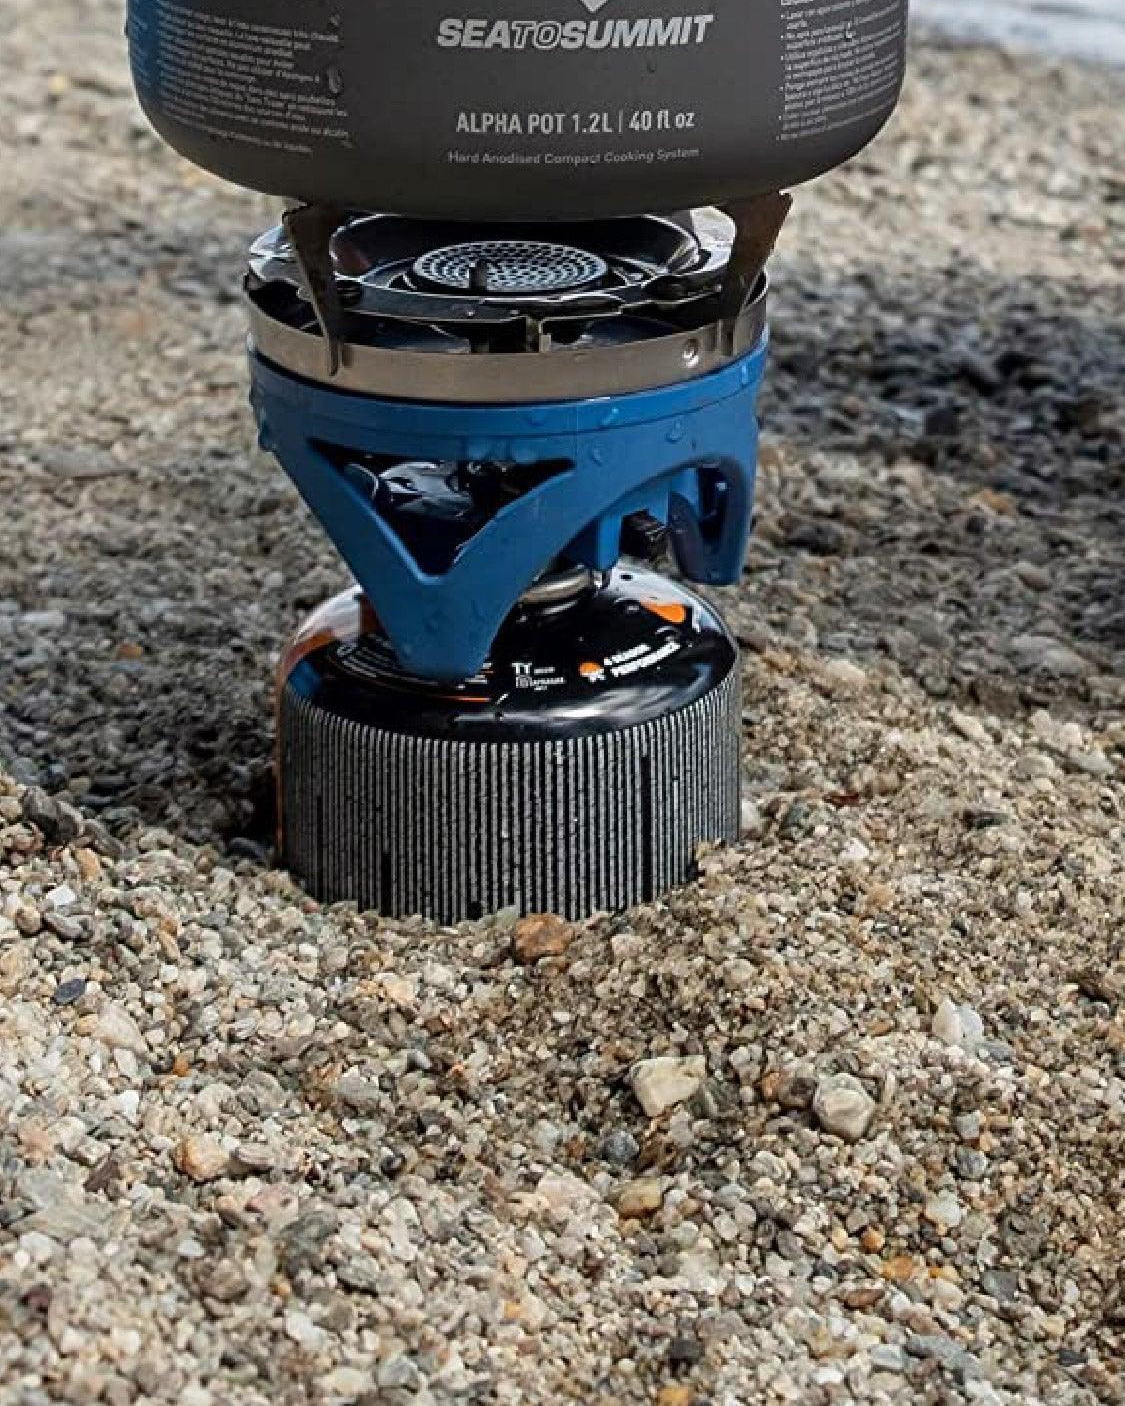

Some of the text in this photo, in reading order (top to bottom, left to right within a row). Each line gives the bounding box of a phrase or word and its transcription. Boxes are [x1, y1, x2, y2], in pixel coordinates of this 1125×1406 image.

[456, 109, 696, 134] ALPHA POT 1.2L 40 fl oz
[448, 150, 480, 164] Hard
[544, 152, 602, 167] Compact
[604, 150, 654, 165] Cooking
[656, 147, 700, 161] System
